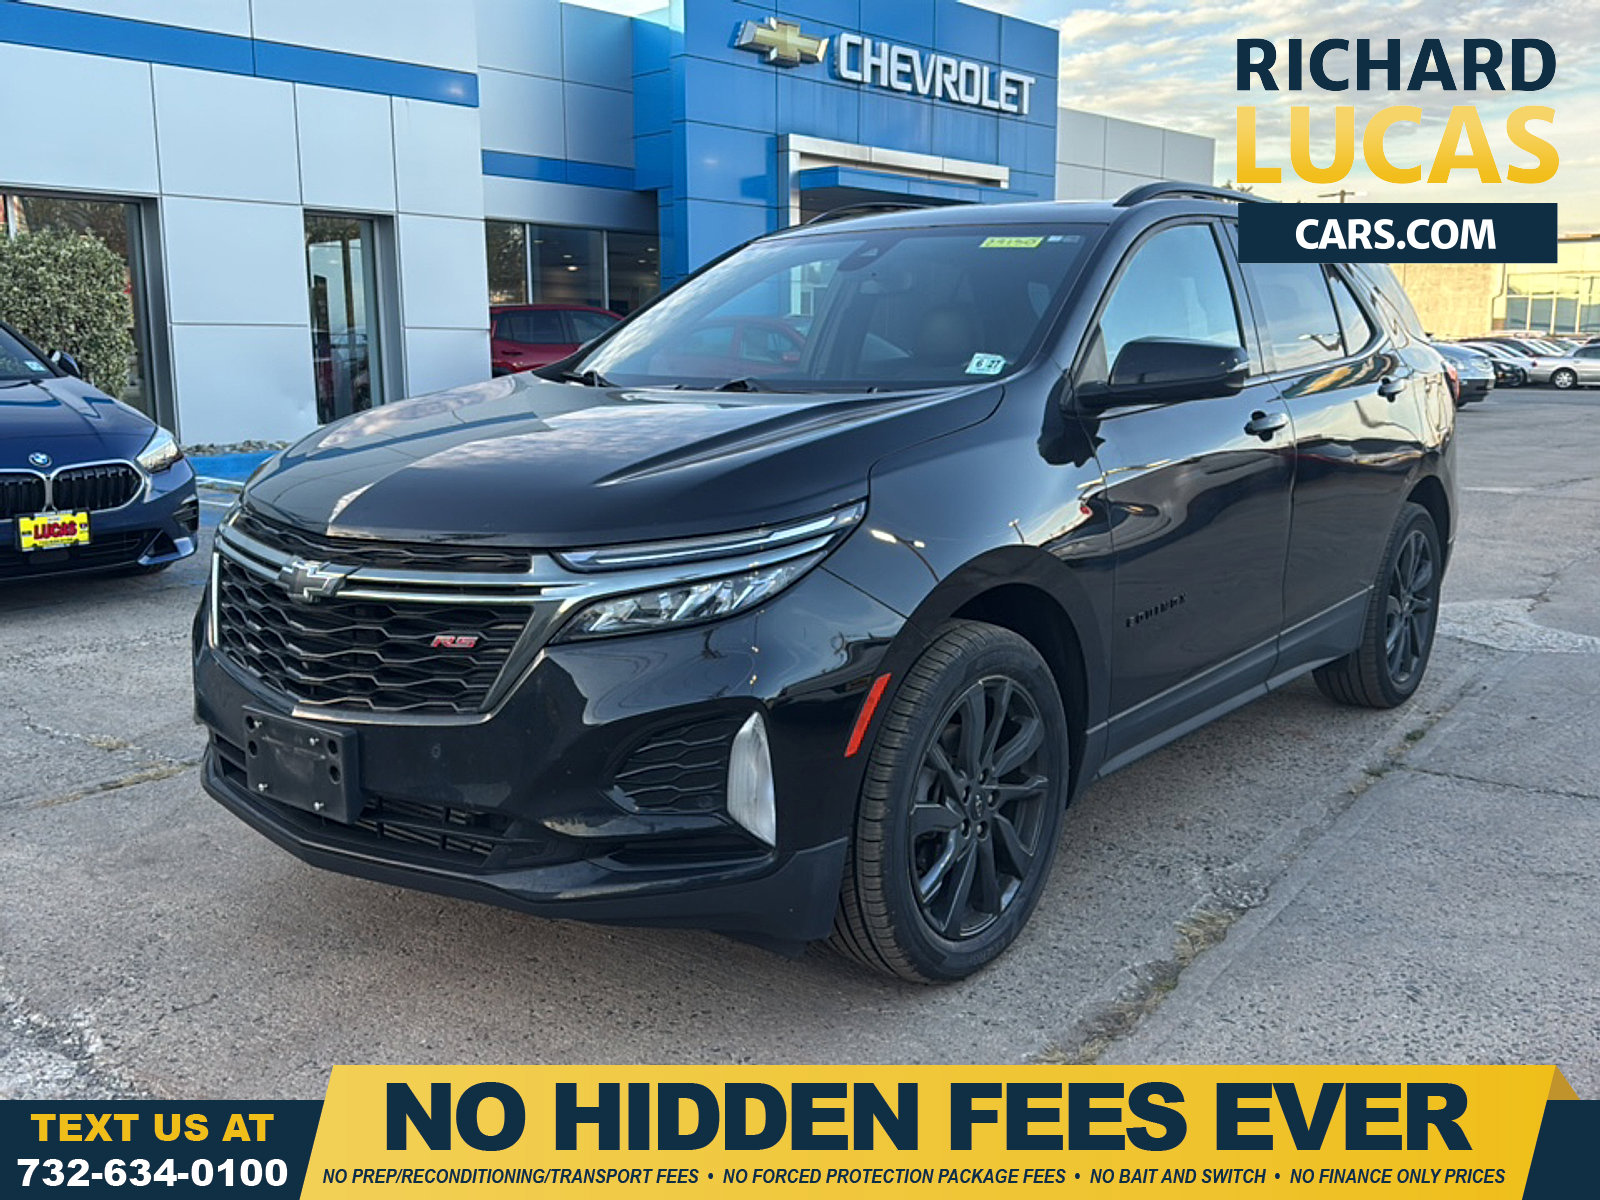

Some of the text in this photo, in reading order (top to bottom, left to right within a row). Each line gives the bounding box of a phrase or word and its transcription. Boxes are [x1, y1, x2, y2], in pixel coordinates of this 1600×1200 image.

[836, 33, 1036, 116] CHEVROLET
[33, 520, 77, 540] LUCAS
[430, 635, 479, 648] RS
